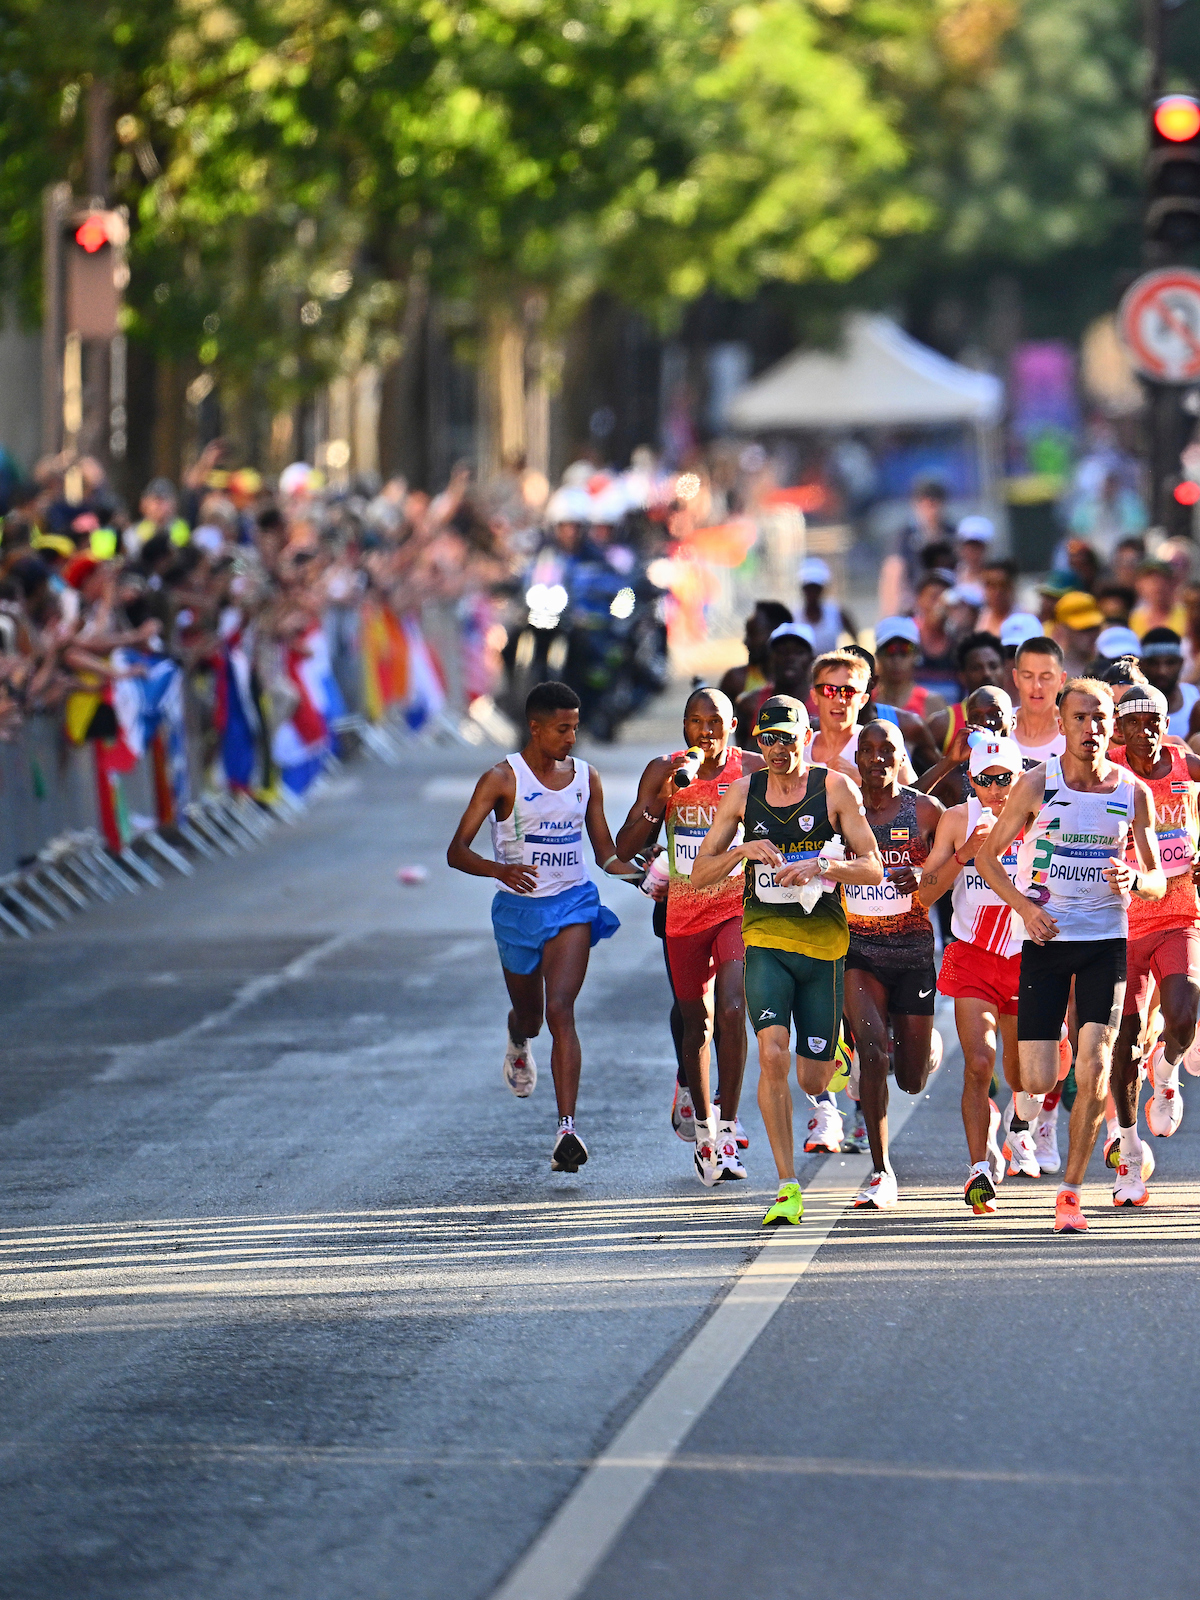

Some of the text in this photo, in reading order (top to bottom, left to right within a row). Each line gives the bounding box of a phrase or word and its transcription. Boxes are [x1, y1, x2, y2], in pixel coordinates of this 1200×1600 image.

[539, 821, 574, 830] ITALIA
[1062, 833, 1115, 846] UZBEKISTAN
[789, 840, 825, 853] AFRIC
[531, 850, 579, 867] FANIEL
[786, 853, 804, 861] 2024
